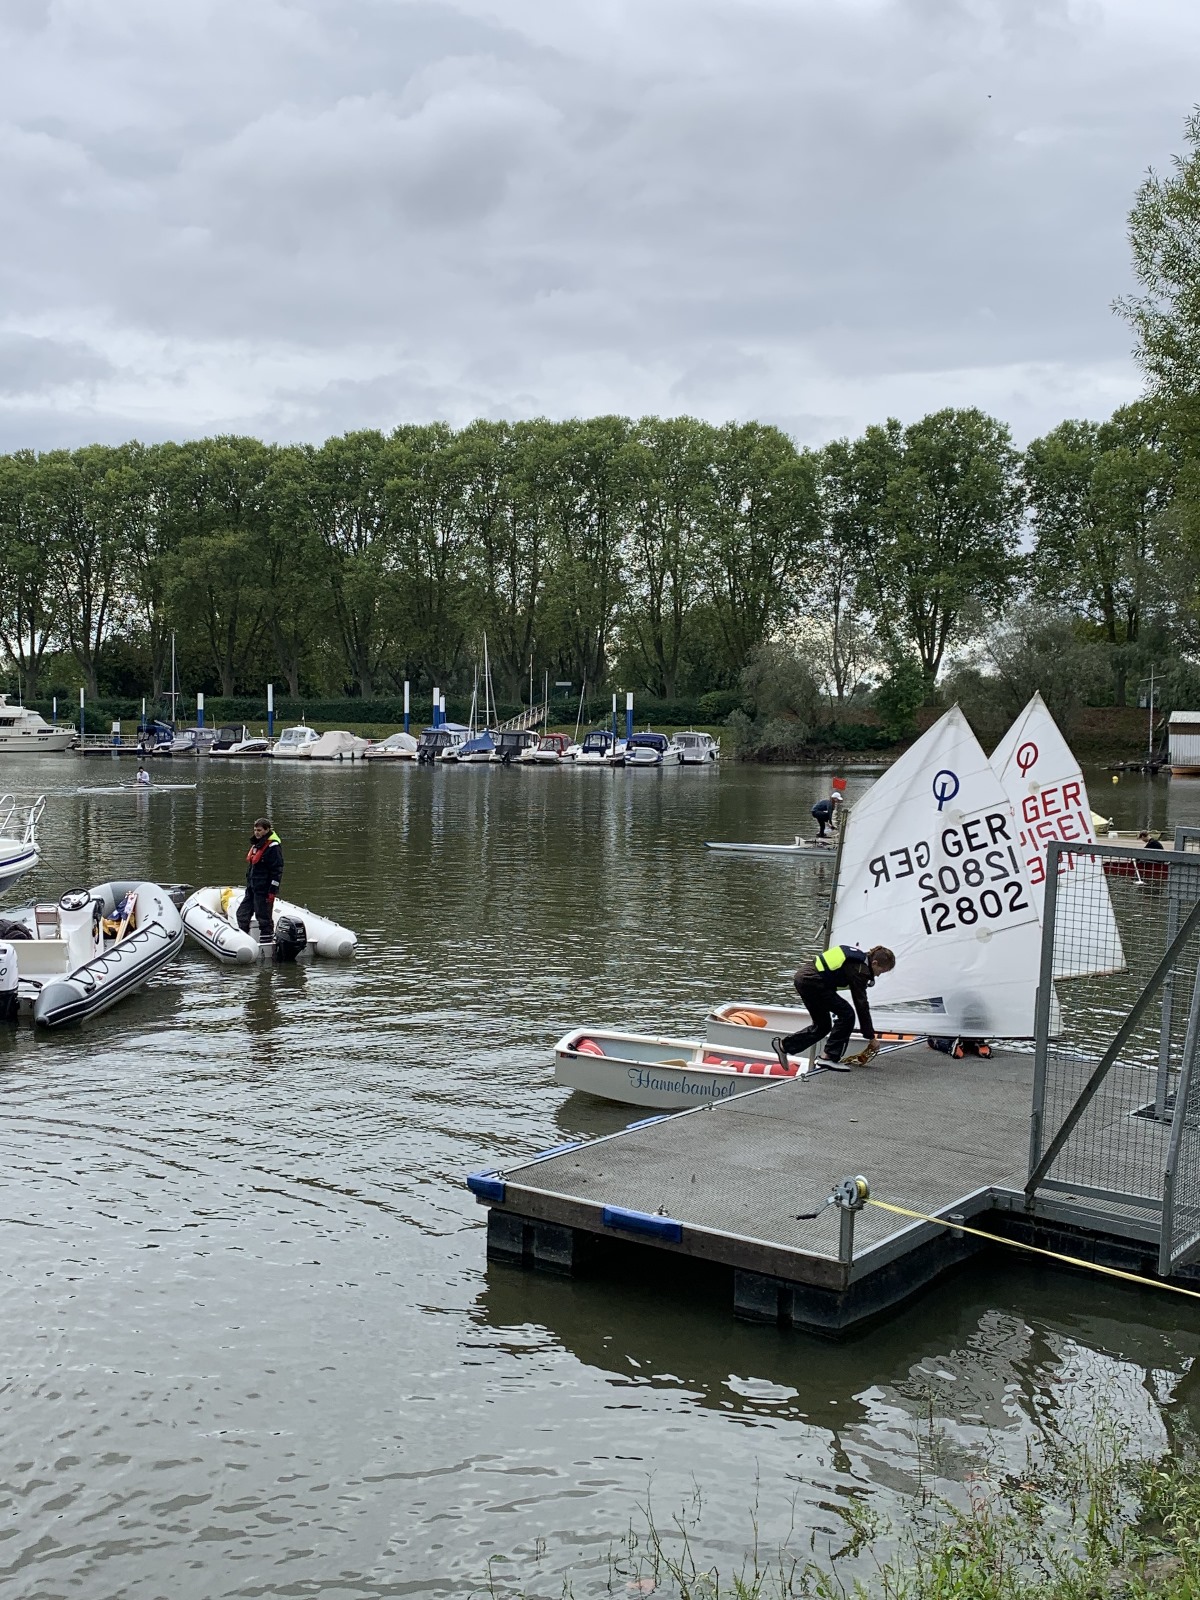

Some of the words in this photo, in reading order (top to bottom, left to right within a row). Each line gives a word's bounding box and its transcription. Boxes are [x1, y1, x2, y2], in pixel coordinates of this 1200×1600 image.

[1021, 782, 1082, 824] GER
[941, 813, 1012, 858] GER
[920, 880, 1029, 935] 12802
[627, 1068, 736, 1098] Hannebambel
